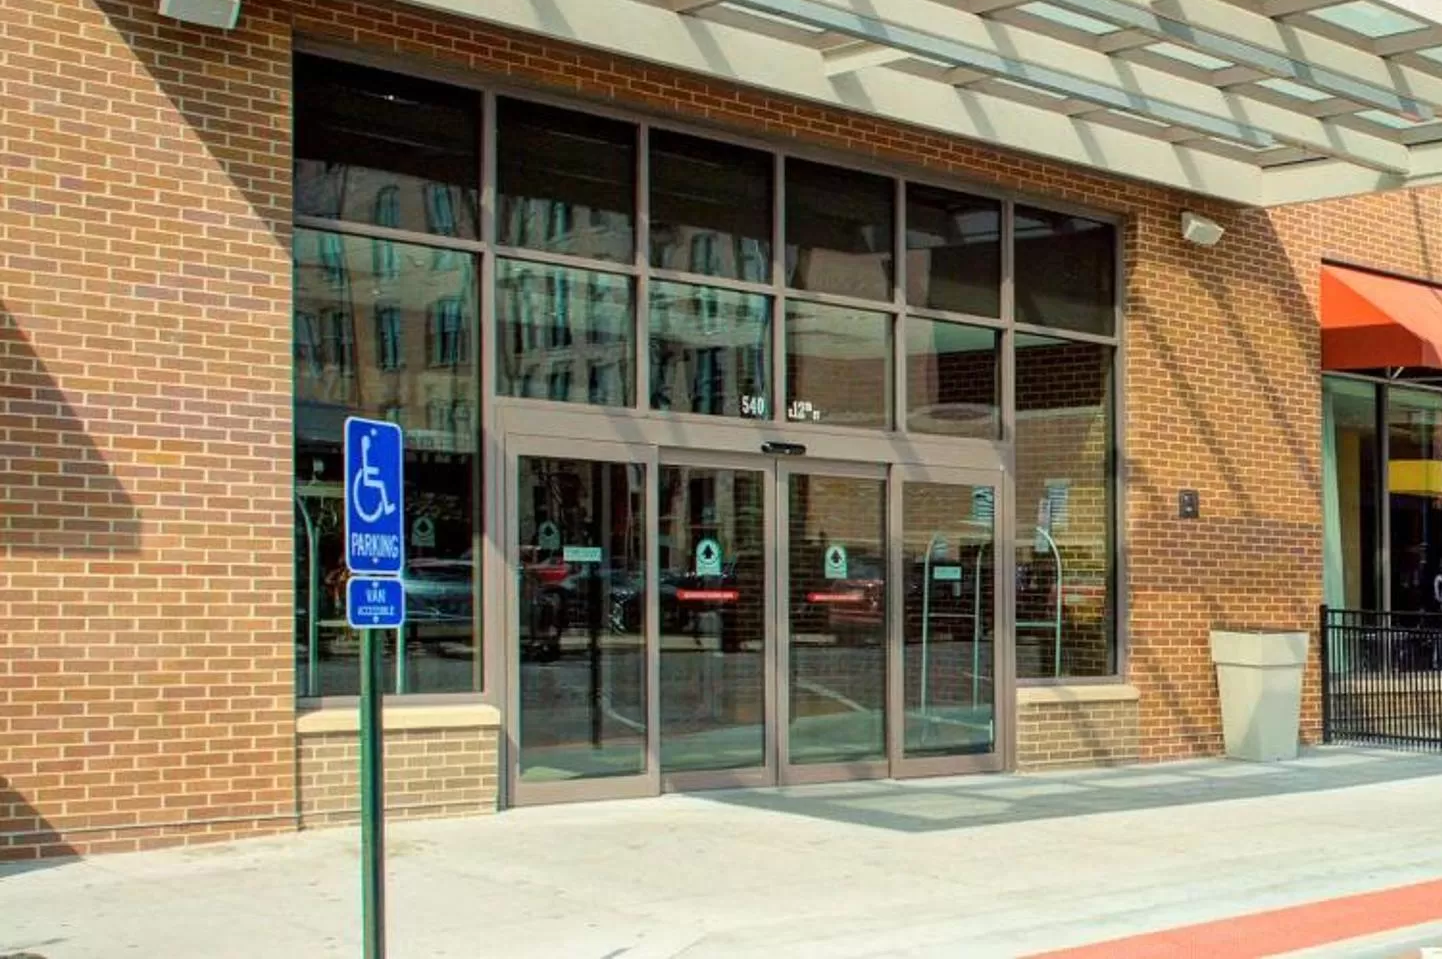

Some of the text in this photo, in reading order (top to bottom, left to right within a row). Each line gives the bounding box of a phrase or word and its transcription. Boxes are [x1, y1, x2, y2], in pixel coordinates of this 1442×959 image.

[741, 395, 765, 415] 540
[351, 531, 400, 559] PARKING
[366, 587, 387, 604] VAN
